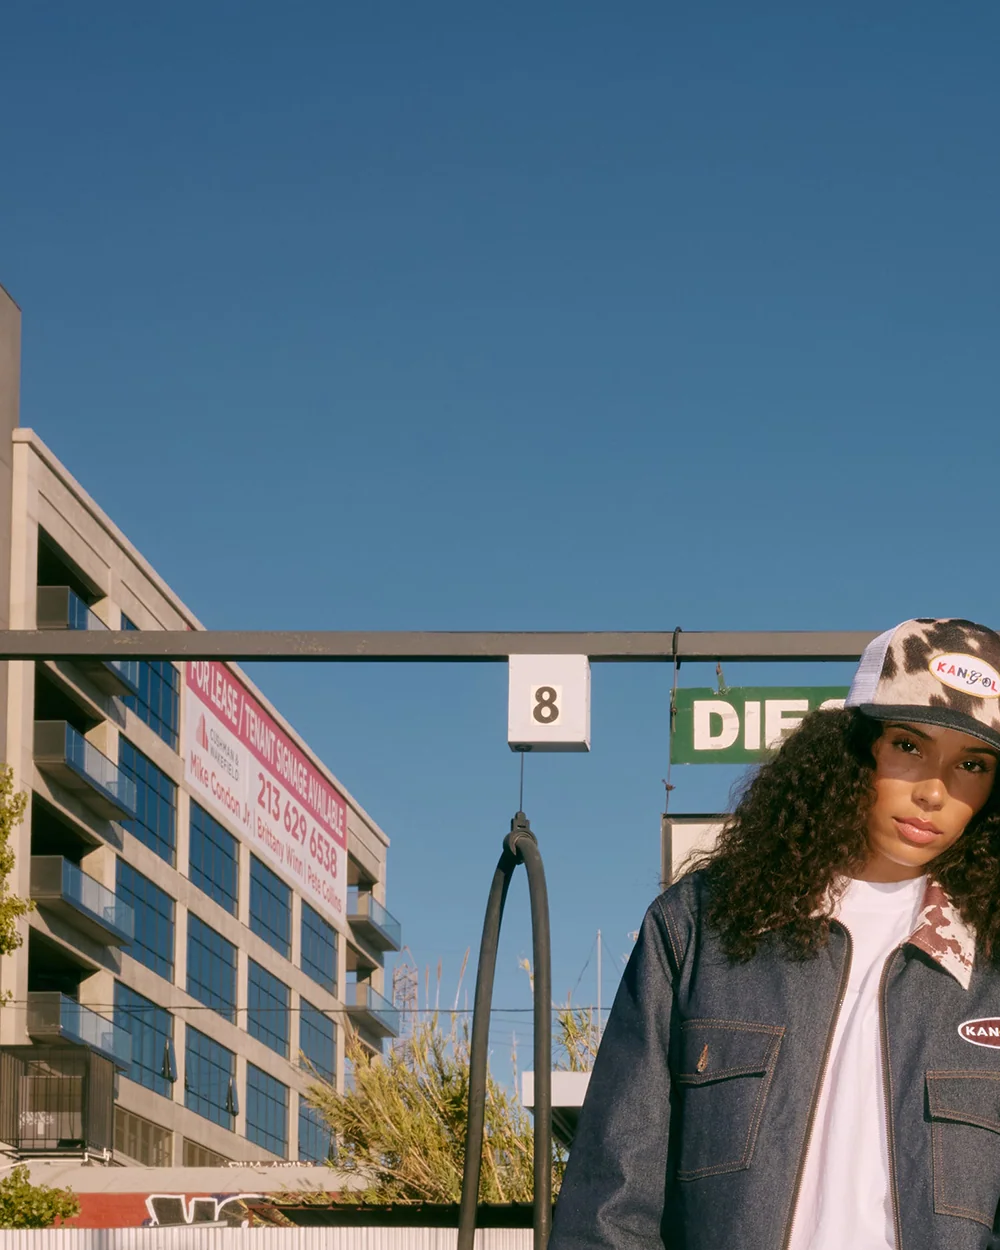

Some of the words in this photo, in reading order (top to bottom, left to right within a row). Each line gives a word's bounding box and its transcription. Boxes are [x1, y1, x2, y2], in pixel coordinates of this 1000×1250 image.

[532, 685, 560, 725] 8
[936, 661, 998, 693] KANGOL
[211, 665, 239, 727] LEASE
[244, 702, 276, 765] TENANT
[276, 738, 308, 800] SIGNAGE
[307, 774, 344, 838] AVAILABLE
[693, 699, 847, 751] DIE
[190, 749, 209, 788] Mike
[210, 771, 241, 820] Condon
[257, 815, 285, 864] Brittany
[307, 864, 321, 895] Pete
[257, 771, 281, 821] 213
[284, 800, 307, 846] 629
[309, 827, 338, 879] 6538
